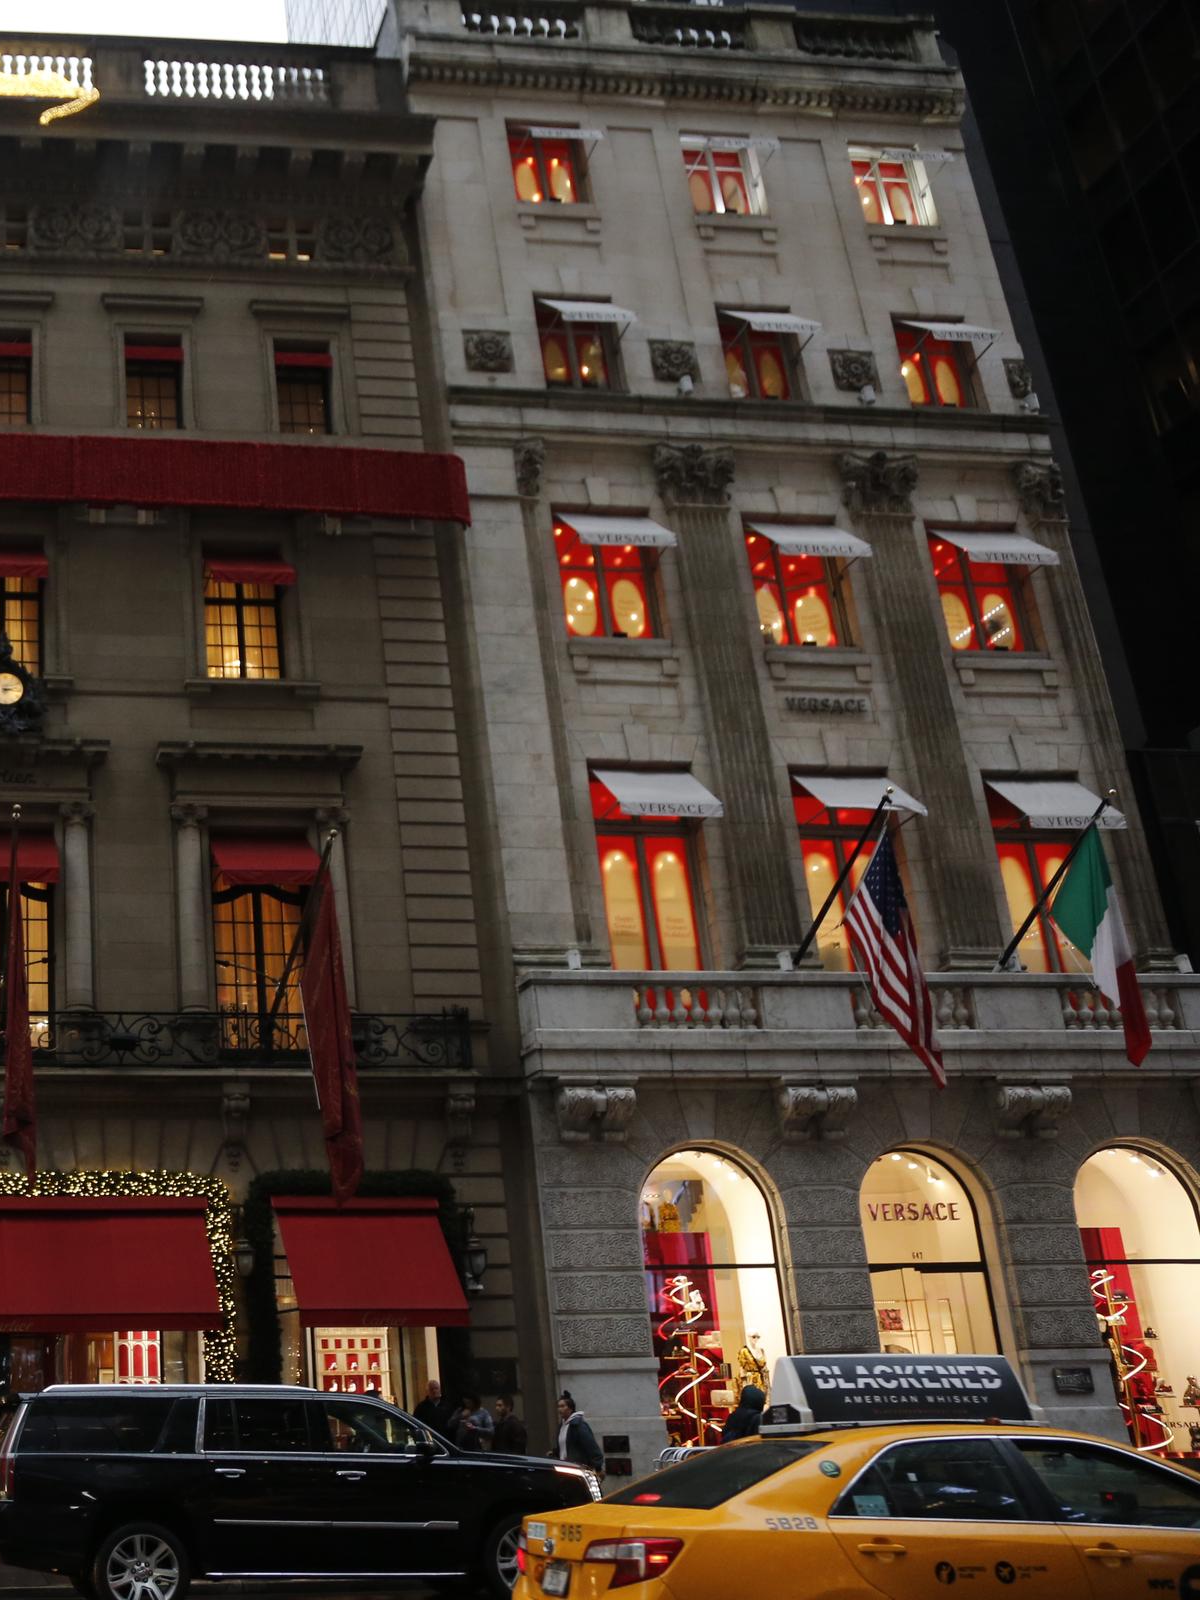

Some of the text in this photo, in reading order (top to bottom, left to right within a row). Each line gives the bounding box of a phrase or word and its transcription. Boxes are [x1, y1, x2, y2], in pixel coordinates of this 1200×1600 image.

[597, 534, 658, 544] VERSACE
[784, 696, 867, 714] VERSACE
[639, 803, 705, 814] VERSACE
[1047, 816, 1111, 826] VERSAE
[867, 1202, 961, 1221] VERSACE
[810, 1365, 1003, 1389] BLACKENED
[844, 1395, 990, 1404] AMERICAN WHISKEY
[560, 1524, 583, 1542] 965
